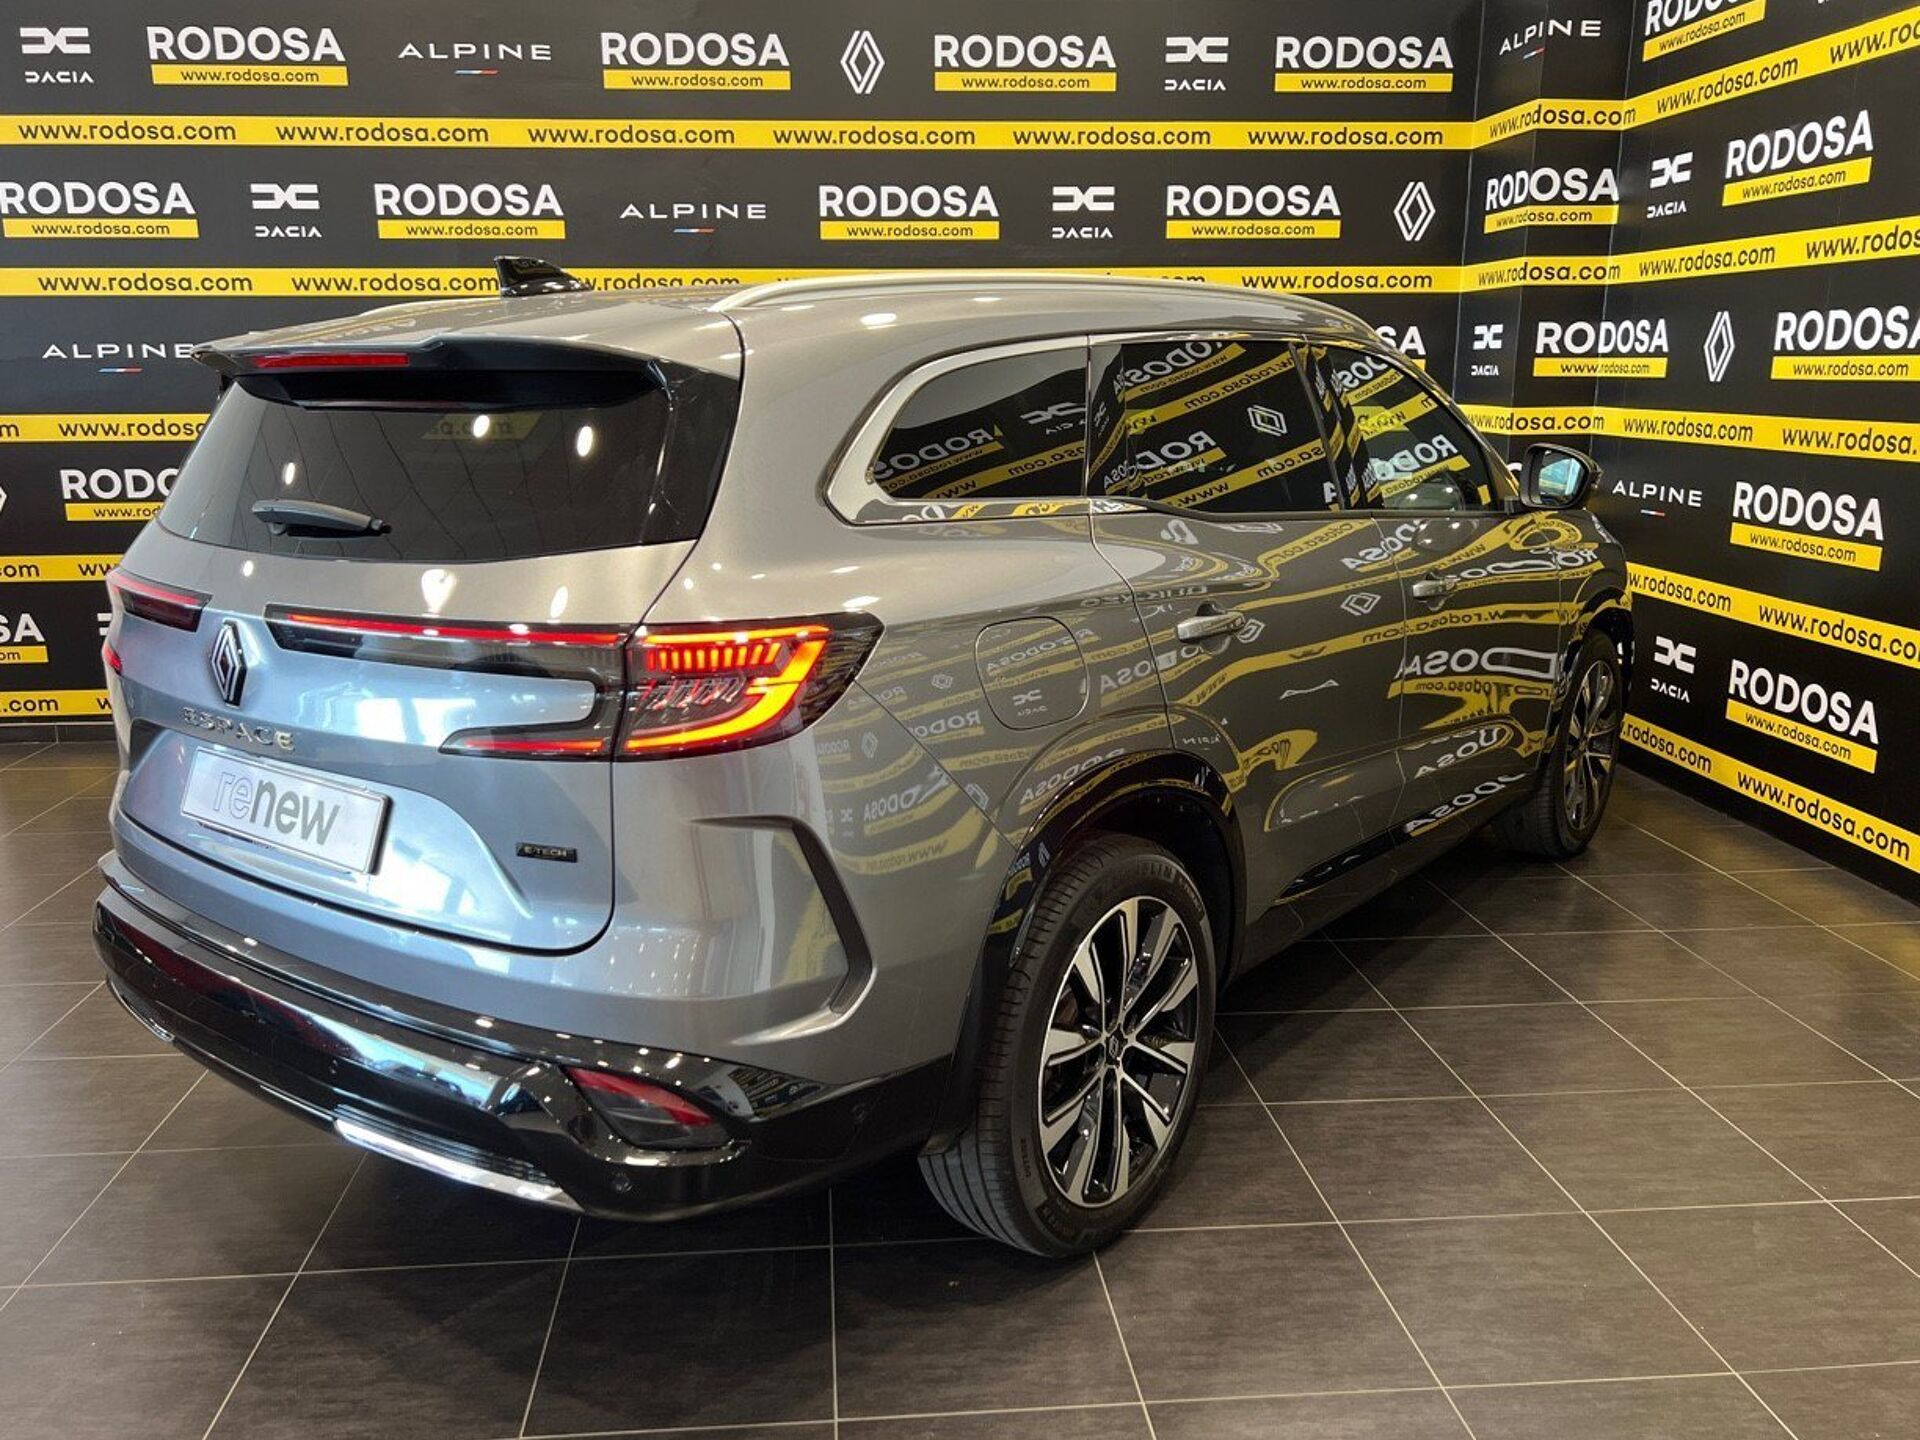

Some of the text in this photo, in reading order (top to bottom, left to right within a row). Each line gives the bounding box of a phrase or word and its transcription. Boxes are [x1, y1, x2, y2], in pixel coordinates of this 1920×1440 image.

[1645, 0, 1737, 36] ROD
[1499, 20, 1602, 56] ALPINE
[1658, 11, 1746, 51] www.rodosa.com
[146, 26, 346, 62] RODOSA
[398, 43, 551, 60] ALPINE
[600, 32, 790, 67] RODOSA
[934, 34, 1117, 69] RODOSA
[1274, 36, 1454, 69] RODOSA
[24, 71, 95, 84] DACIA
[181, 69, 320, 83] www.rodosa.com
[631, 74, 764, 88] www.rodosa.com
[961, 75, 1090, 89] www.rodosa.com
[1164, 79, 1227, 91] DACIA
[1300, 77, 1427, 90] www.rodosa.com
[1657, 57, 1799, 114] www.rodosa.com
[18, 121, 236, 141] www.rodosa.com
[276, 123, 490, 143] www.rodosa.com
[1489, 105, 1636, 138] www.rodosa.com
[528, 125, 735, 145] www.rodosa.com
[773, 126, 976, 145] www.rodosa.com
[1013, 126, 1211, 146] www.rodosa.com
[1247, 127, 1443, 146] www.rodosa.com
[1725, 109, 1874, 179] RODOSA
[1485, 167, 1620, 211] RODOSA
[1743, 168, 1846, 199] www.rodosa.com
[0, 181, 196, 215] RODOSA
[374, 182, 564, 217] RODOSA
[819, 185, 1000, 217] RODOSA
[1166, 185, 1342, 217] RODOSA
[1646, 200, 1687, 219] DACIA
[619, 203, 767, 219] ALPINE
[1496, 209, 1593, 228] www.rodosa.com
[32, 223, 170, 236] www.rodosa.com
[254, 226, 323, 239] DACIA
[406, 223, 539, 237] www.rodosa.com
[847, 224, 973, 237] www.rodosa.com
[1052, 227, 1113, 239] DACIA
[1191, 223, 1316, 236] www.rodosa.com
[1639, 244, 1776, 278] www.rodosa.com
[38, 272, 253, 293] www.rodosa.com
[291, 272, 499, 293] www.rodosa.com
[1242, 271, 1433, 290] www.rodosa.com
[1478, 262, 1621, 287] www.rodosa.com
[1535, 318, 1669, 354] RODOSA
[42, 343, 194, 359] ALPINE
[1561, 361, 1650, 375] www.rodosa.com
[1793, 360, 1909, 377] www.rodosa.com
[1623, 416, 1753, 442] www.rodosa.com
[1612, 480, 1703, 508] ALPINE
[1732, 480, 1884, 540] RODOSA
[1750, 531, 1857, 562] www.rodosa.com
[1759, 604, 1920, 662] www.rodosa.co
[1650, 678, 1691, 703] DACIA
[1727, 659, 1880, 745] RODOSA
[182, 706, 296, 751] ESPACE
[1745, 711, 1852, 760] www.rodosa.com
[212, 771, 341, 846] renew
[1737, 771, 1910, 862] www.rodosa.com
